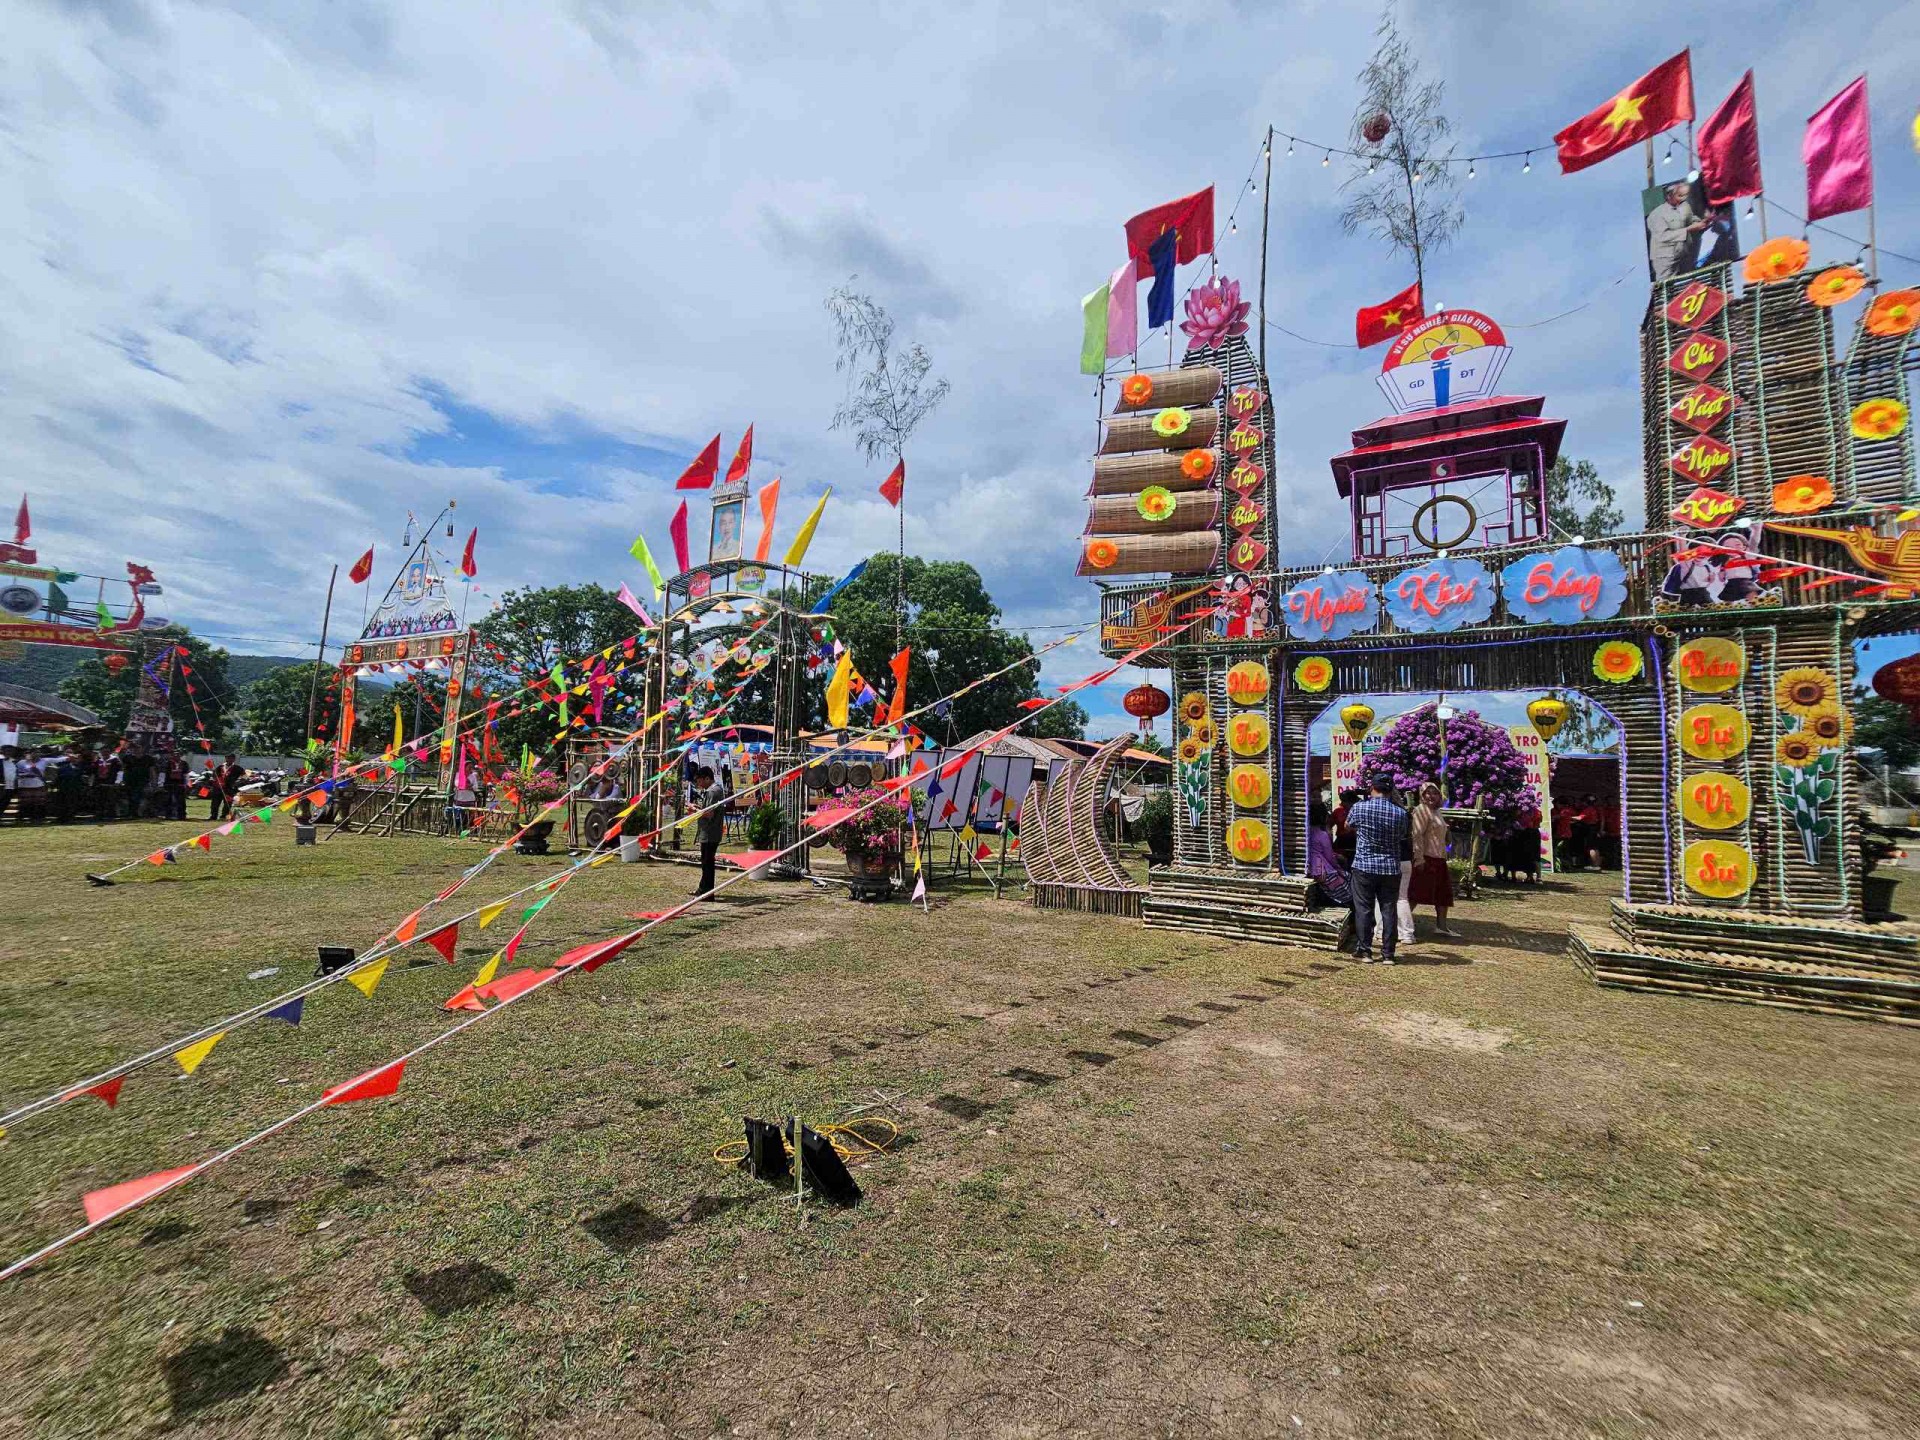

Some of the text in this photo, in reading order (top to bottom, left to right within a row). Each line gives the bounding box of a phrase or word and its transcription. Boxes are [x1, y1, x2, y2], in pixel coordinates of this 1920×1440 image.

[1681, 287, 1708, 323] Ý
[1451, 313, 1473, 323] GIÁO
[1473, 319, 1492, 333] DỤC
[1684, 342, 1716, 370] Chí
[1409, 379, 1425, 389] GD
[1460, 368, 1476, 379] ĐT
[1680, 393, 1730, 421] Vượt
[1230, 429, 1259, 451] Thức
[1680, 445, 1730, 478] Ngàn
[1289, 584, 1368, 633] Người
[1524, 562, 1603, 613] Sáng
[1681, 648, 1740, 678] Bán
[1692, 716, 1734, 750] Tự
[1698, 852, 1738, 883] Sư
